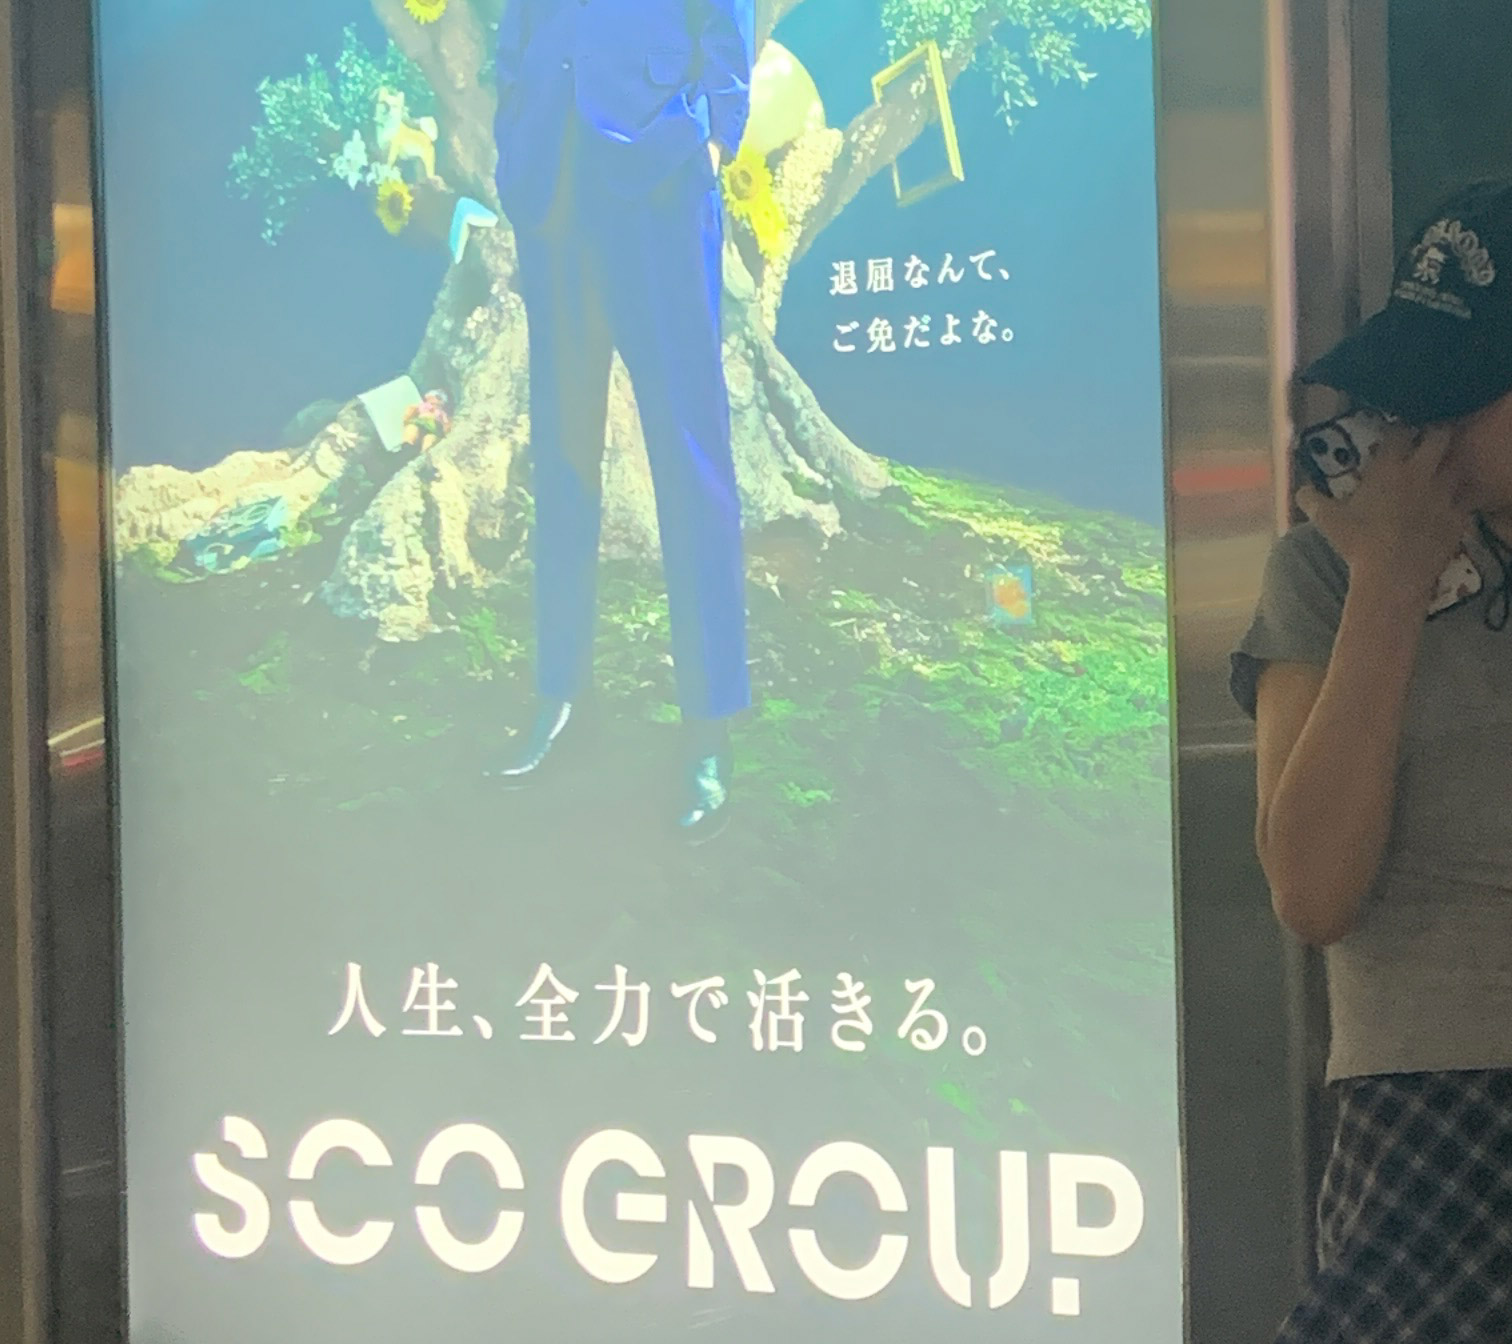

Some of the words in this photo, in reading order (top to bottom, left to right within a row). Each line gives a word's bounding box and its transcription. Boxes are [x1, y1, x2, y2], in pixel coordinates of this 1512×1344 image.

[829, 250, 1010, 295] 退屈なんて、
[833, 310, 1014, 353] ご免だよな。
[328, 962, 988, 1057] 人生、全力で活きる。
[193, 1115, 525, 1273] SCO
[560, 1129, 1145, 1316] GROUP
